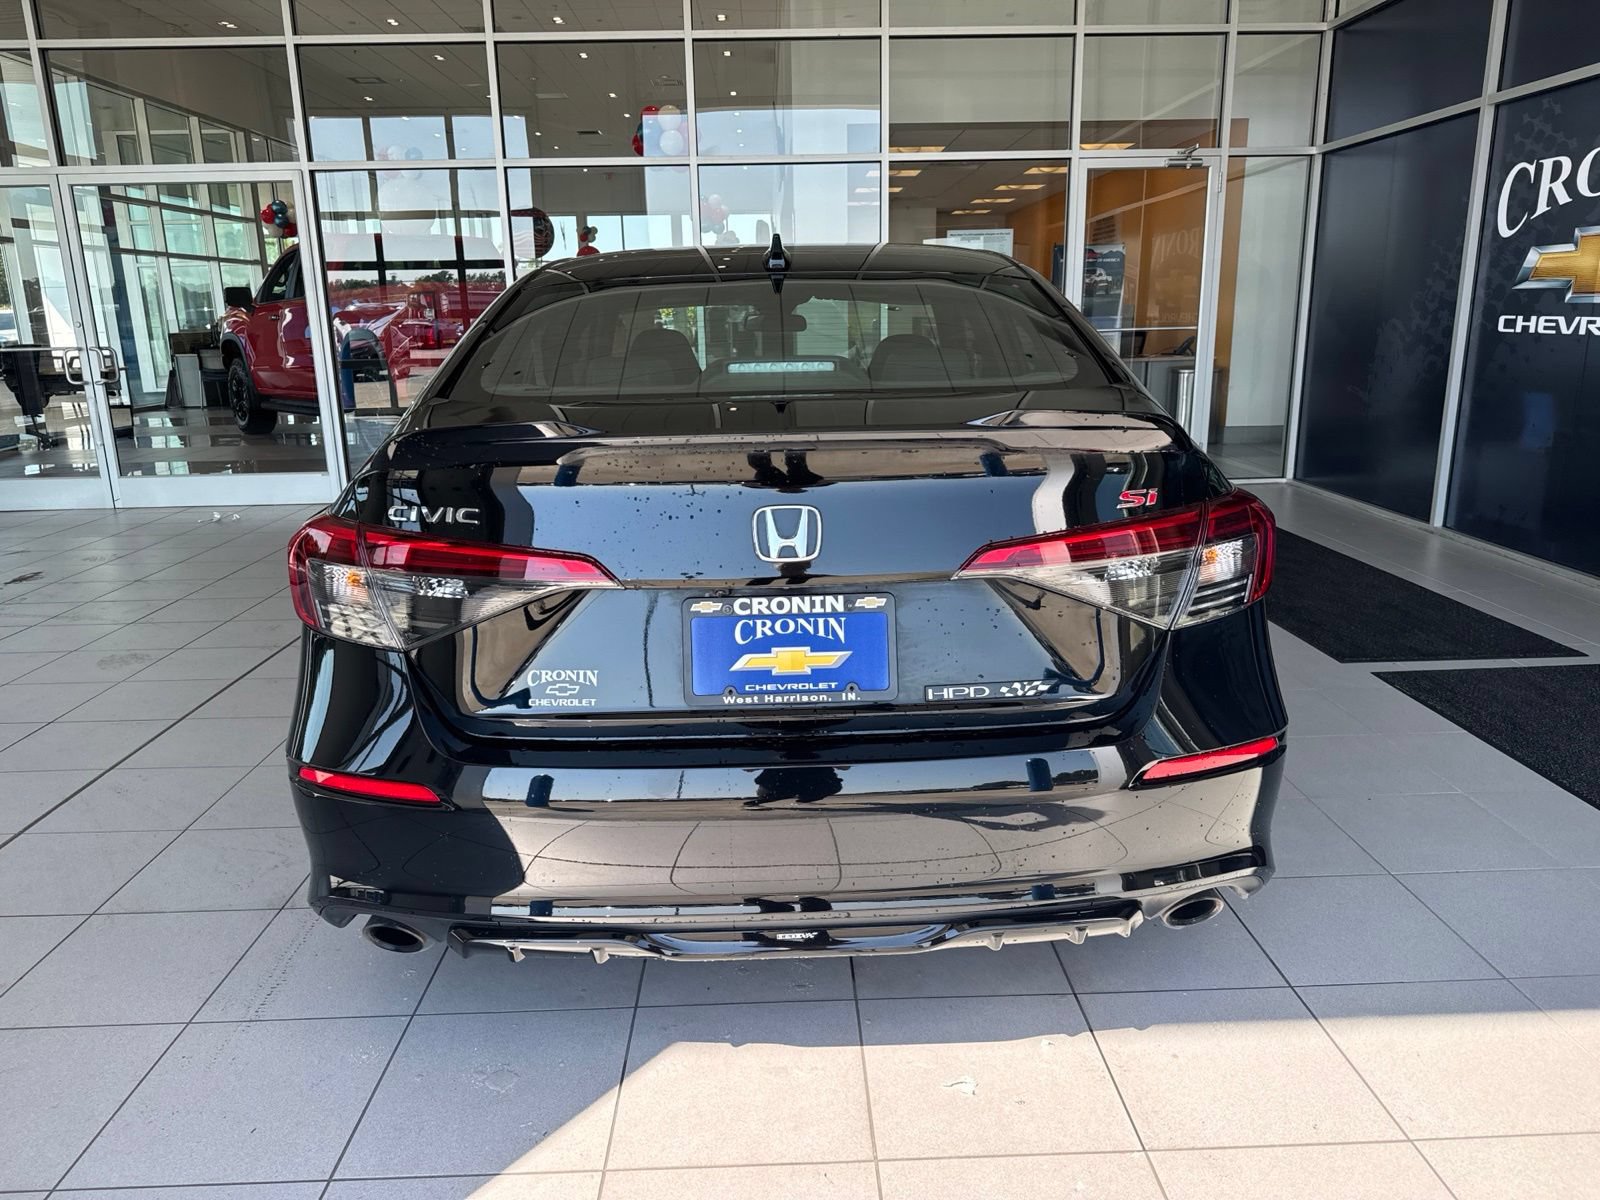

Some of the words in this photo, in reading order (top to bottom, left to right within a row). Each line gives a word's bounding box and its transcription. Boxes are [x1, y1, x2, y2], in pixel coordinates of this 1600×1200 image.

[1116, 488, 1158, 509] Si
[388, 505, 479, 524] CIVIC
[733, 595, 844, 615] CRONIN
[734, 617, 846, 645] CRONIN
[527, 669, 599, 687] CRONIN
[745, 682, 838, 691] CHEVROLET
[528, 698, 597, 706] CHEVROLET
[723, 695, 758, 704] West
[928, 686, 990, 700] HPD
